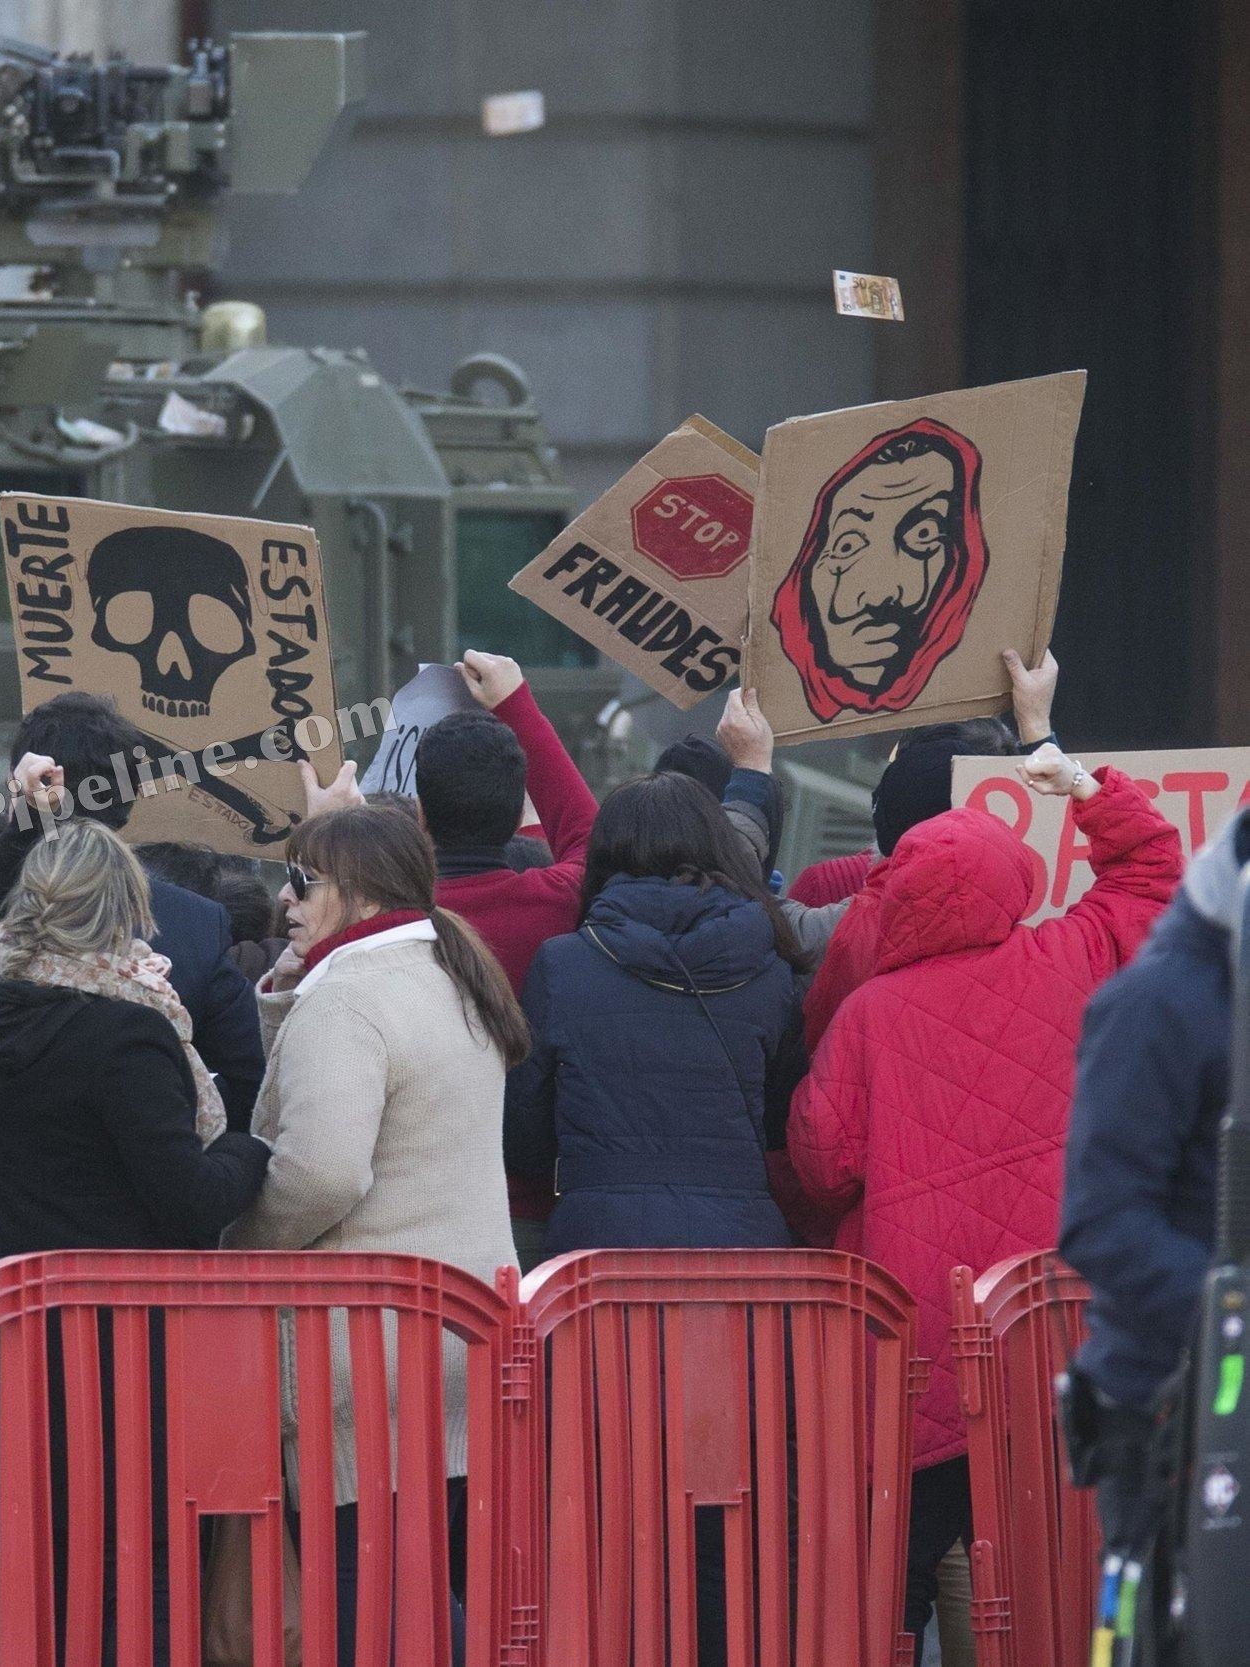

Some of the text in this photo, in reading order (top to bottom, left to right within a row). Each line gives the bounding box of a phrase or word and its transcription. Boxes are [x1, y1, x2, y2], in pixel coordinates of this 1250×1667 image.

[4, 502, 75, 685] MUERTE
[653, 493, 743, 552] STOP
[259, 538, 319, 720] ESTADO
[542, 541, 742, 692] FRAUDES
